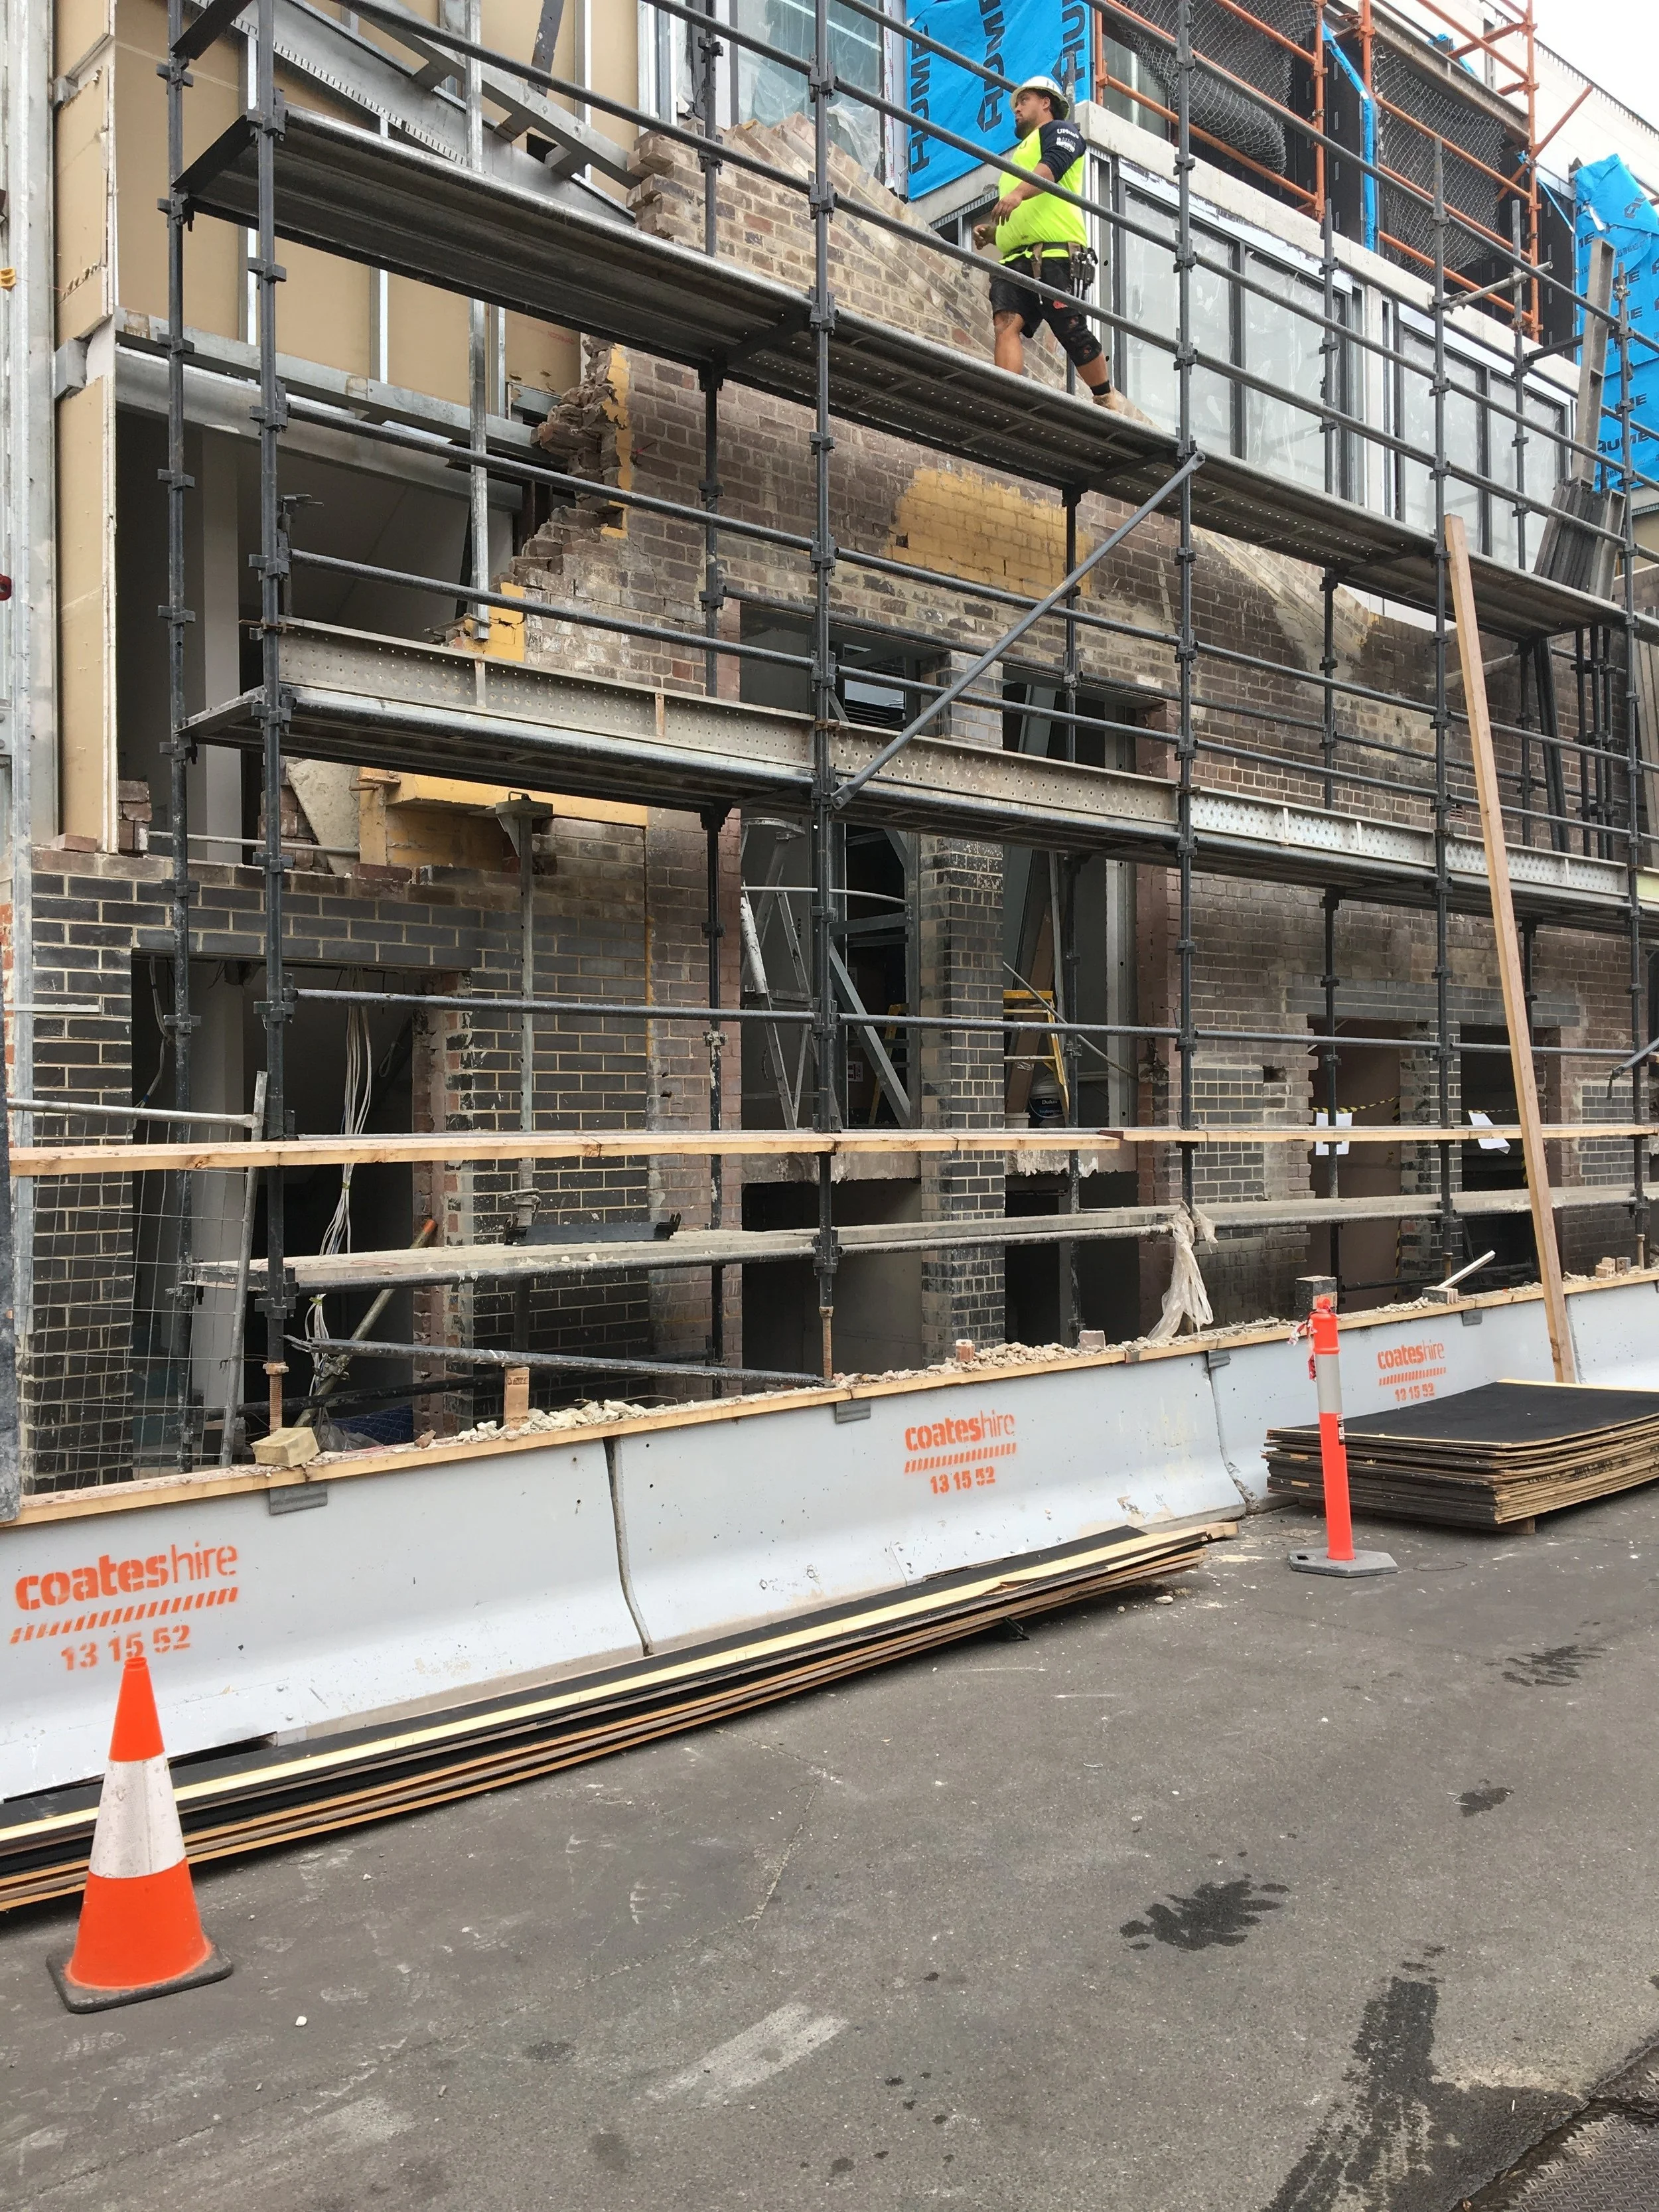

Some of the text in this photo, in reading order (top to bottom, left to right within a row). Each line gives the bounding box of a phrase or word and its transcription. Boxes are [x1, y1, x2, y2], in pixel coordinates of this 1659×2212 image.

[1395, 1382, 1435, 1402] 13 15 52
[904, 1408, 1015, 1451] coateshire
[930, 1465, 995, 1494] 13 15 52
[15, 1540, 238, 1611] coateshire
[60, 1624, 191, 1671] 13 15 52
